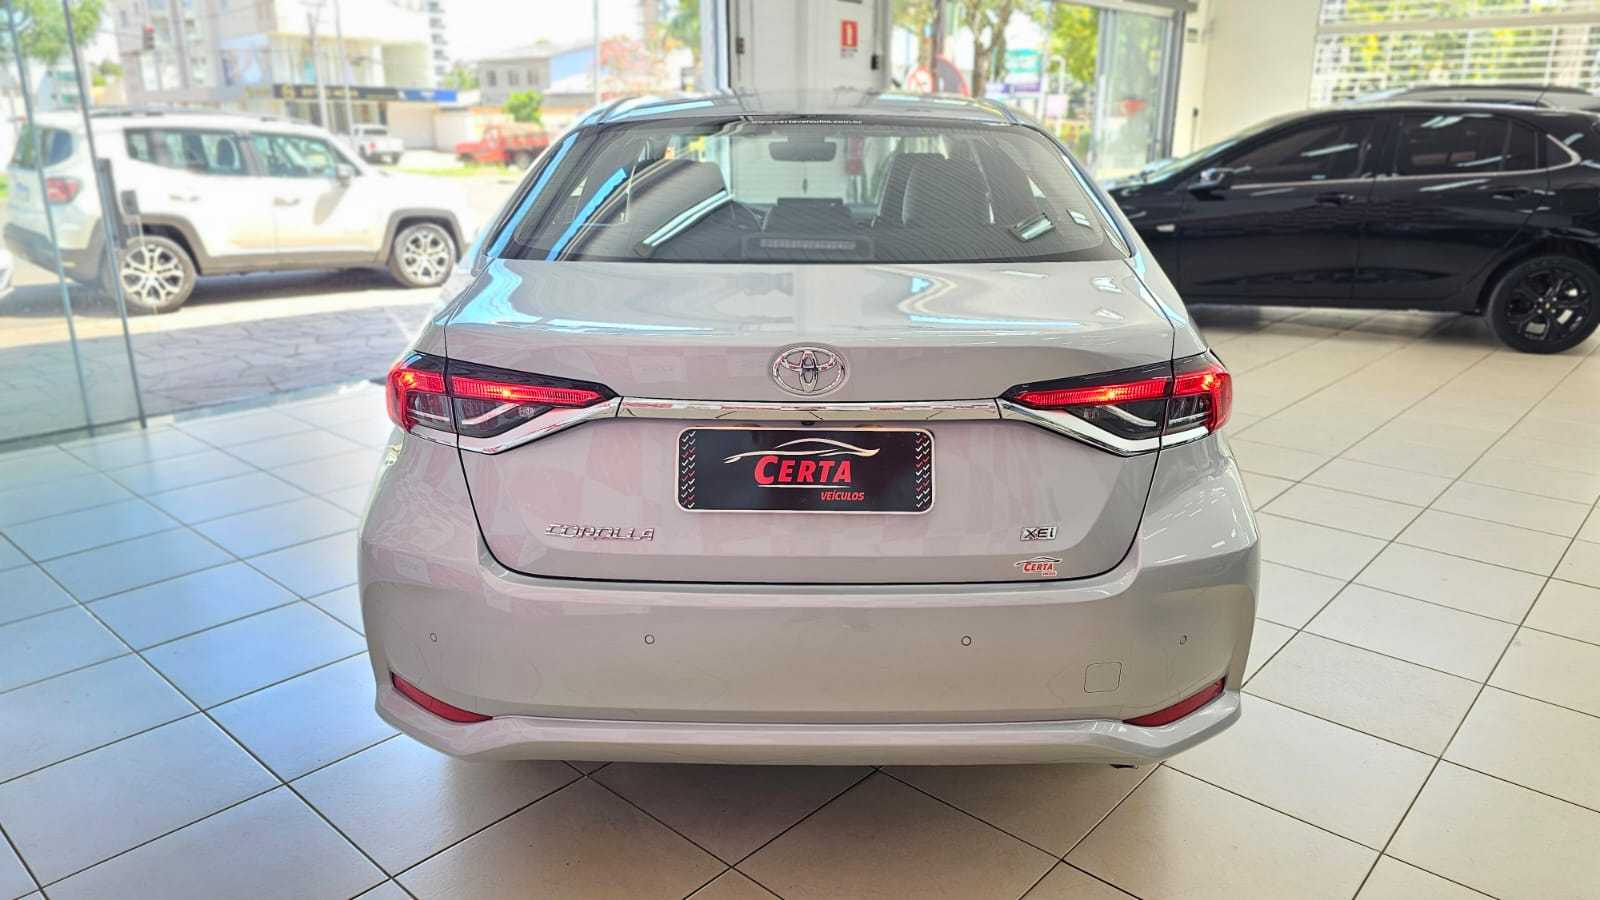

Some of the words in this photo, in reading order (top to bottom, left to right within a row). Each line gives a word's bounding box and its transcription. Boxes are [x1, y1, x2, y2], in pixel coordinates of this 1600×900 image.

[754, 455, 853, 485] CERTA
[820, 490, 865, 502] VEÍCULOS
[544, 523, 656, 541] COROLLA
